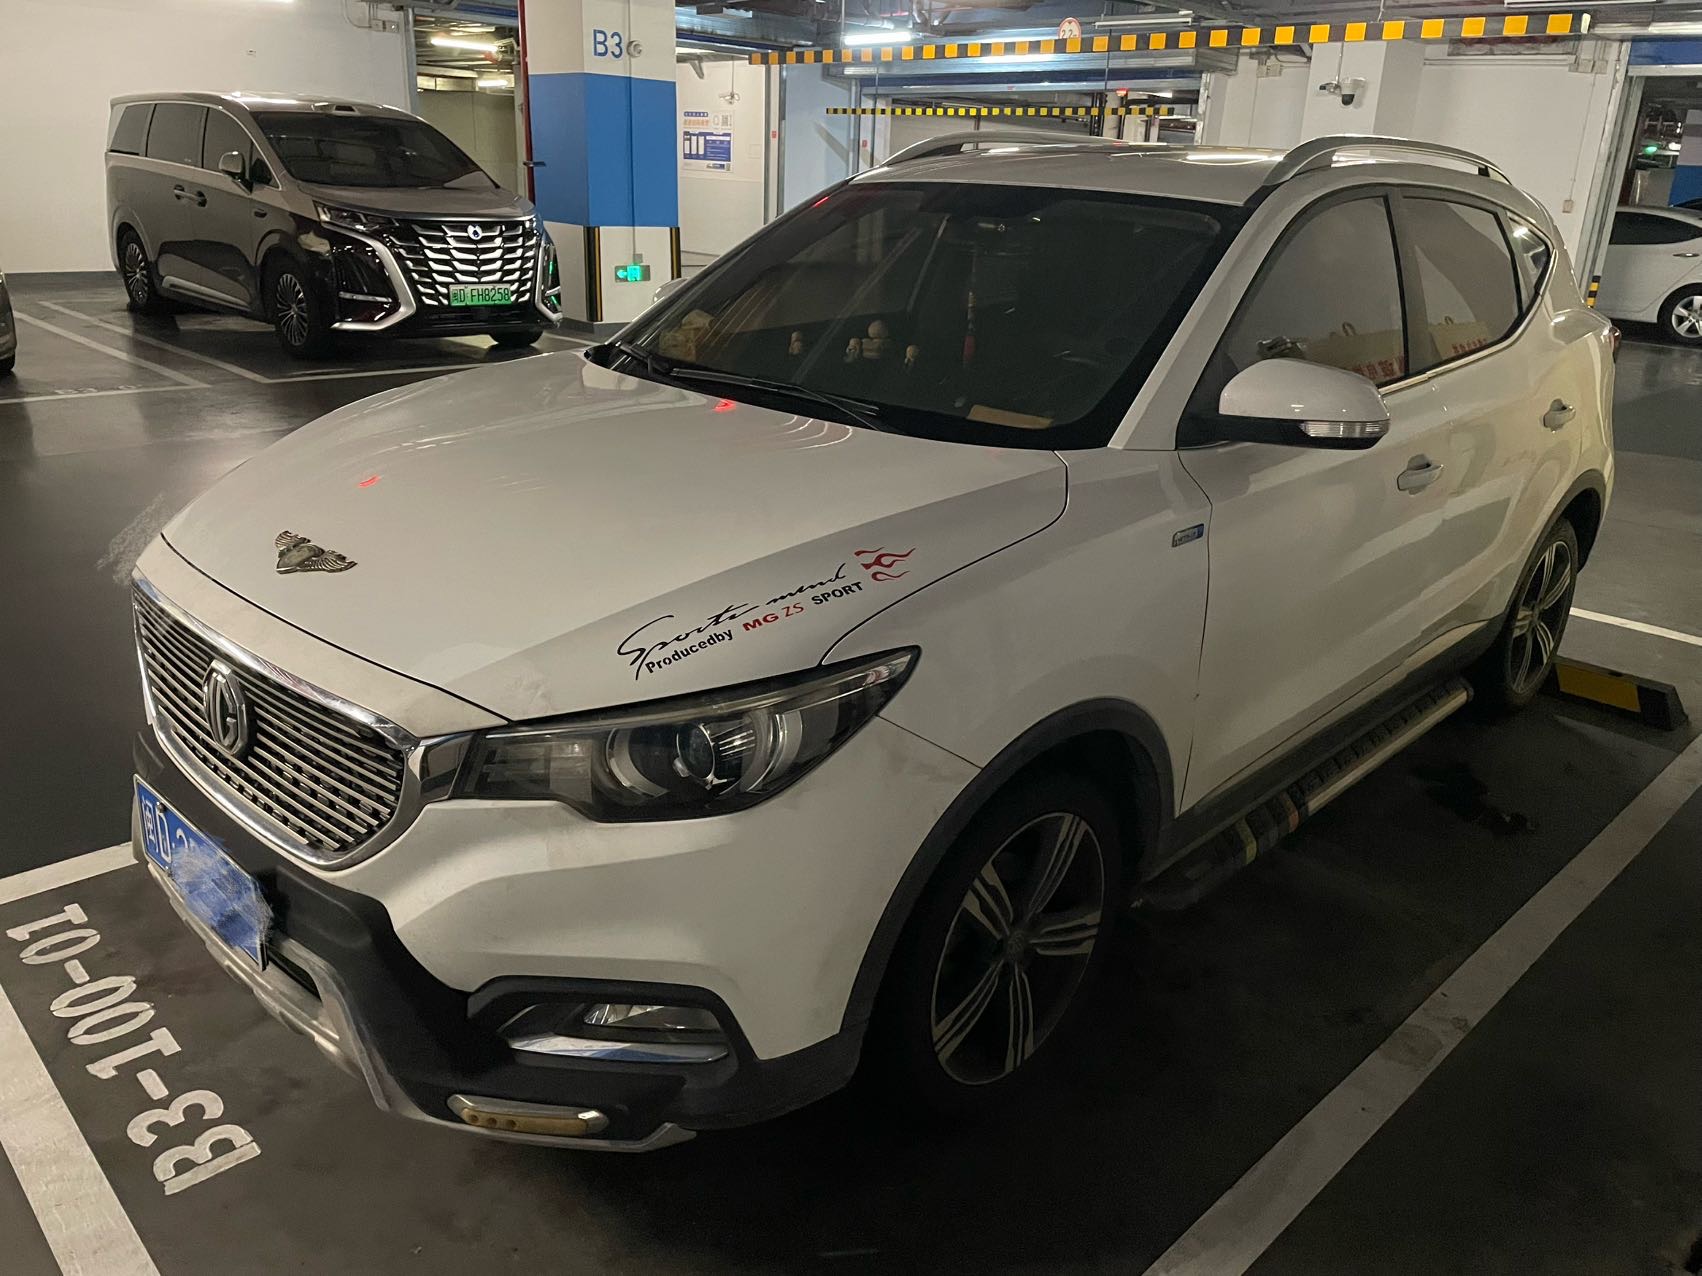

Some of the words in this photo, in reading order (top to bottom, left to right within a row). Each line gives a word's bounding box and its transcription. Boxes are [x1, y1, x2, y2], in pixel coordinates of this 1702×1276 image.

[593, 29, 623, 58] B3
[470, 287, 511, 303] FH8258
[645, 629, 733, 673] Producedby
[742, 613, 779, 637] MG
[781, 602, 804, 618] ZS
[811, 581, 863, 605] SPORT
[6, 903, 261, 1195] B3-100-01
